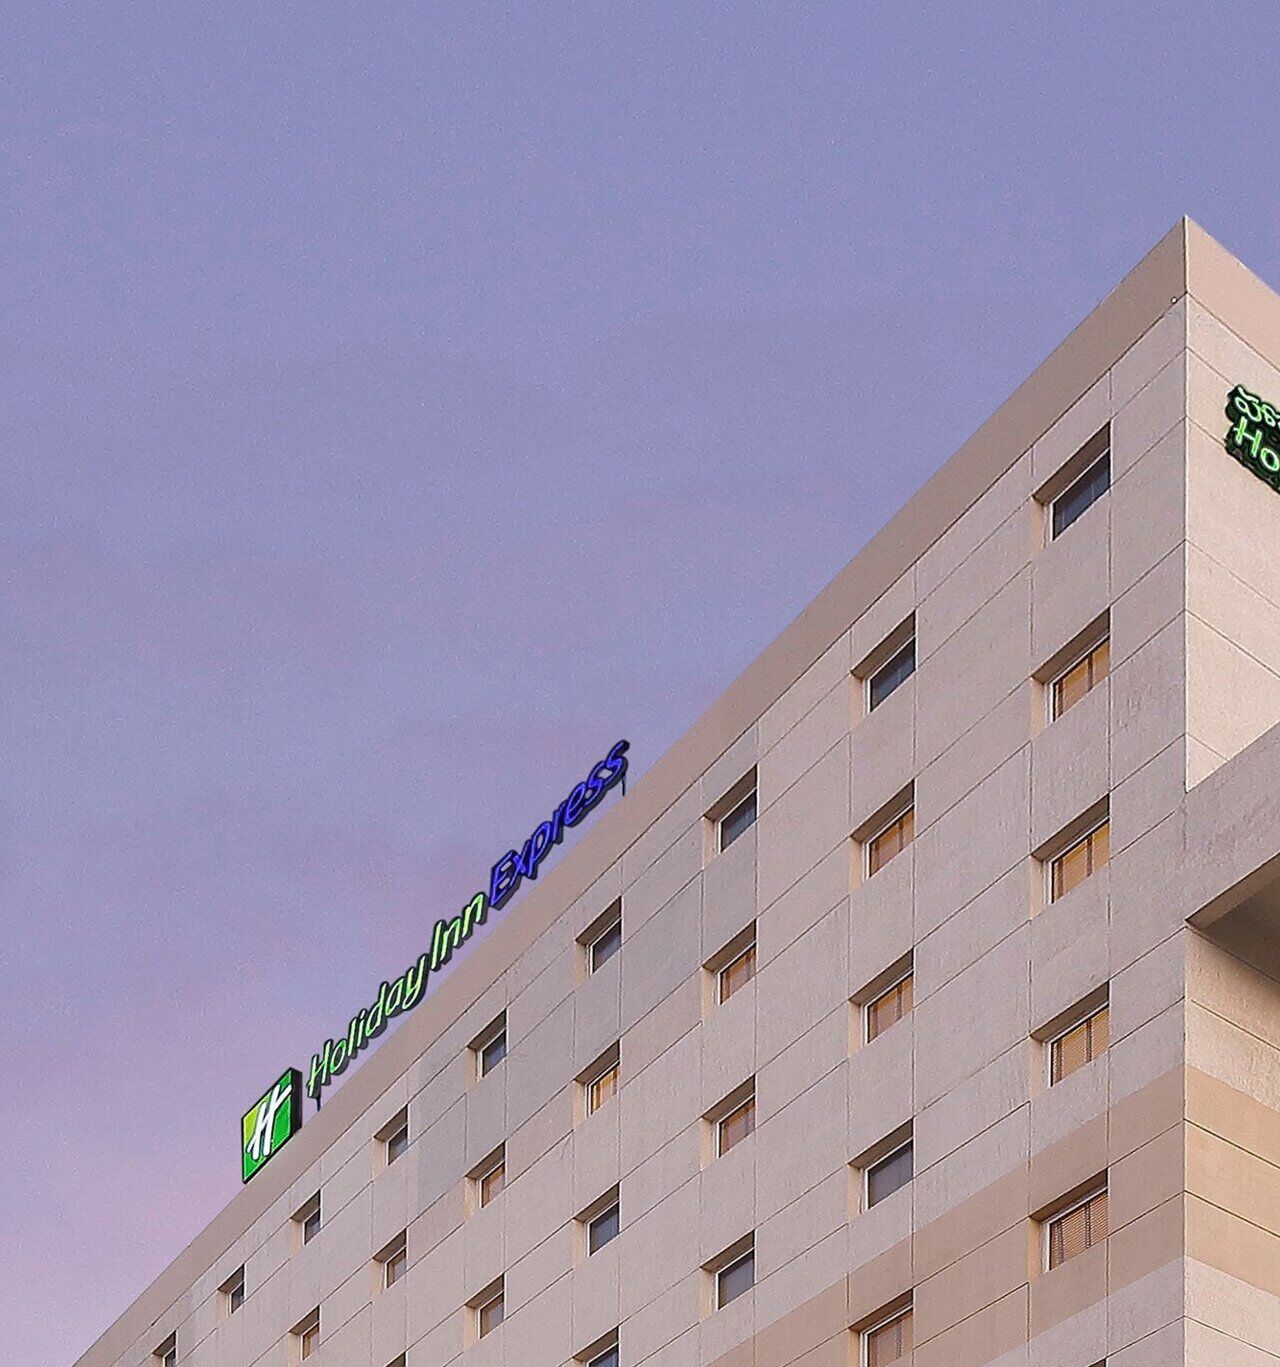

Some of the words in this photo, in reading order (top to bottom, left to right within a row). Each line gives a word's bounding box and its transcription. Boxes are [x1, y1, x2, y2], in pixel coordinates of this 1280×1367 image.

[306, 953, 427, 1098] Holiday
[429, 891, 487, 971] Inn
[489, 739, 629, 906] Express
